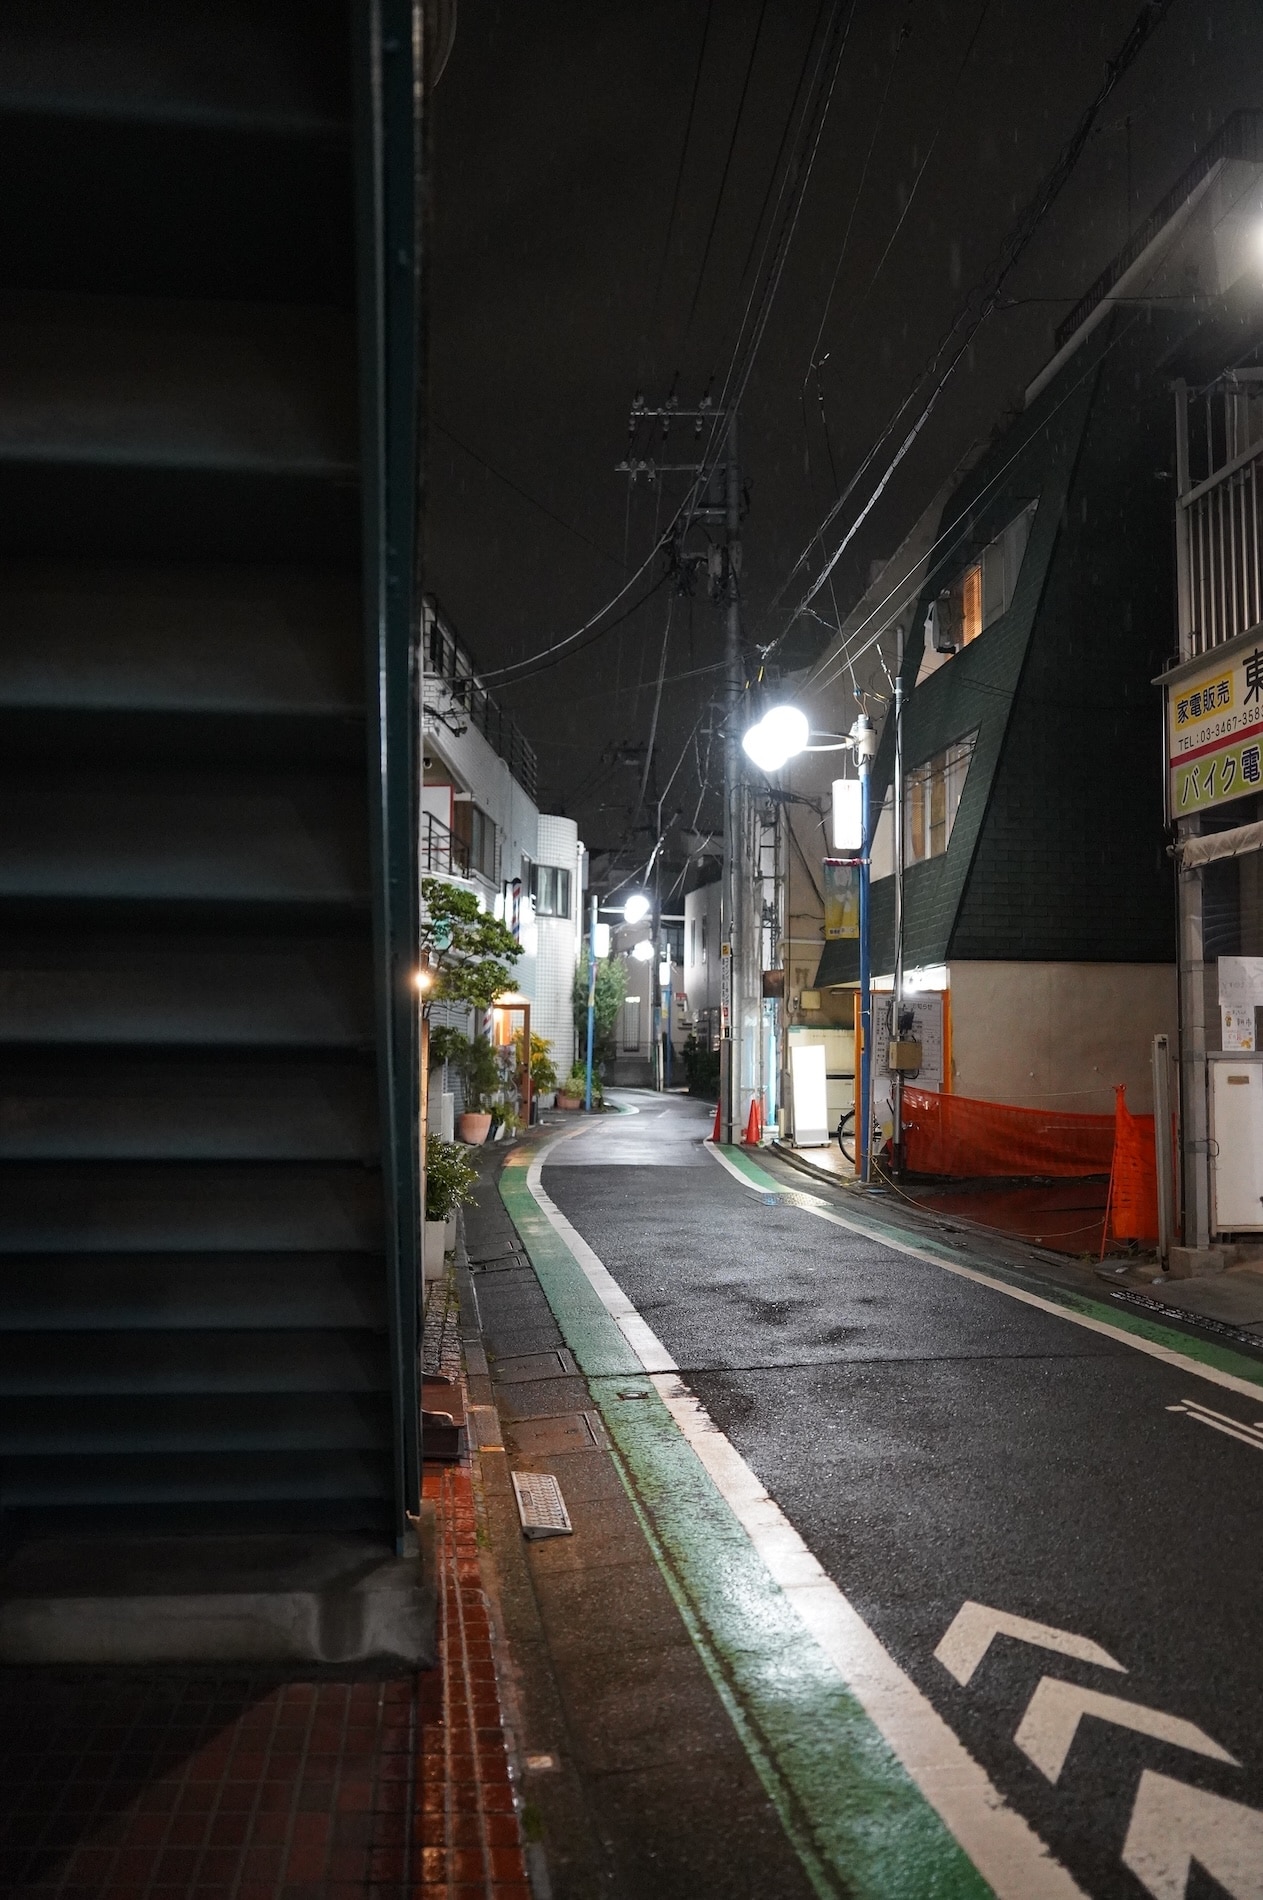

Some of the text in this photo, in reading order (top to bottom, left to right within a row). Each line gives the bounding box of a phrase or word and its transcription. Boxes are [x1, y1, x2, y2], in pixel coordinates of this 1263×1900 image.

[1177, 681, 1230, 724] 家電販売
[1182, 746, 1261, 805] バイク電
